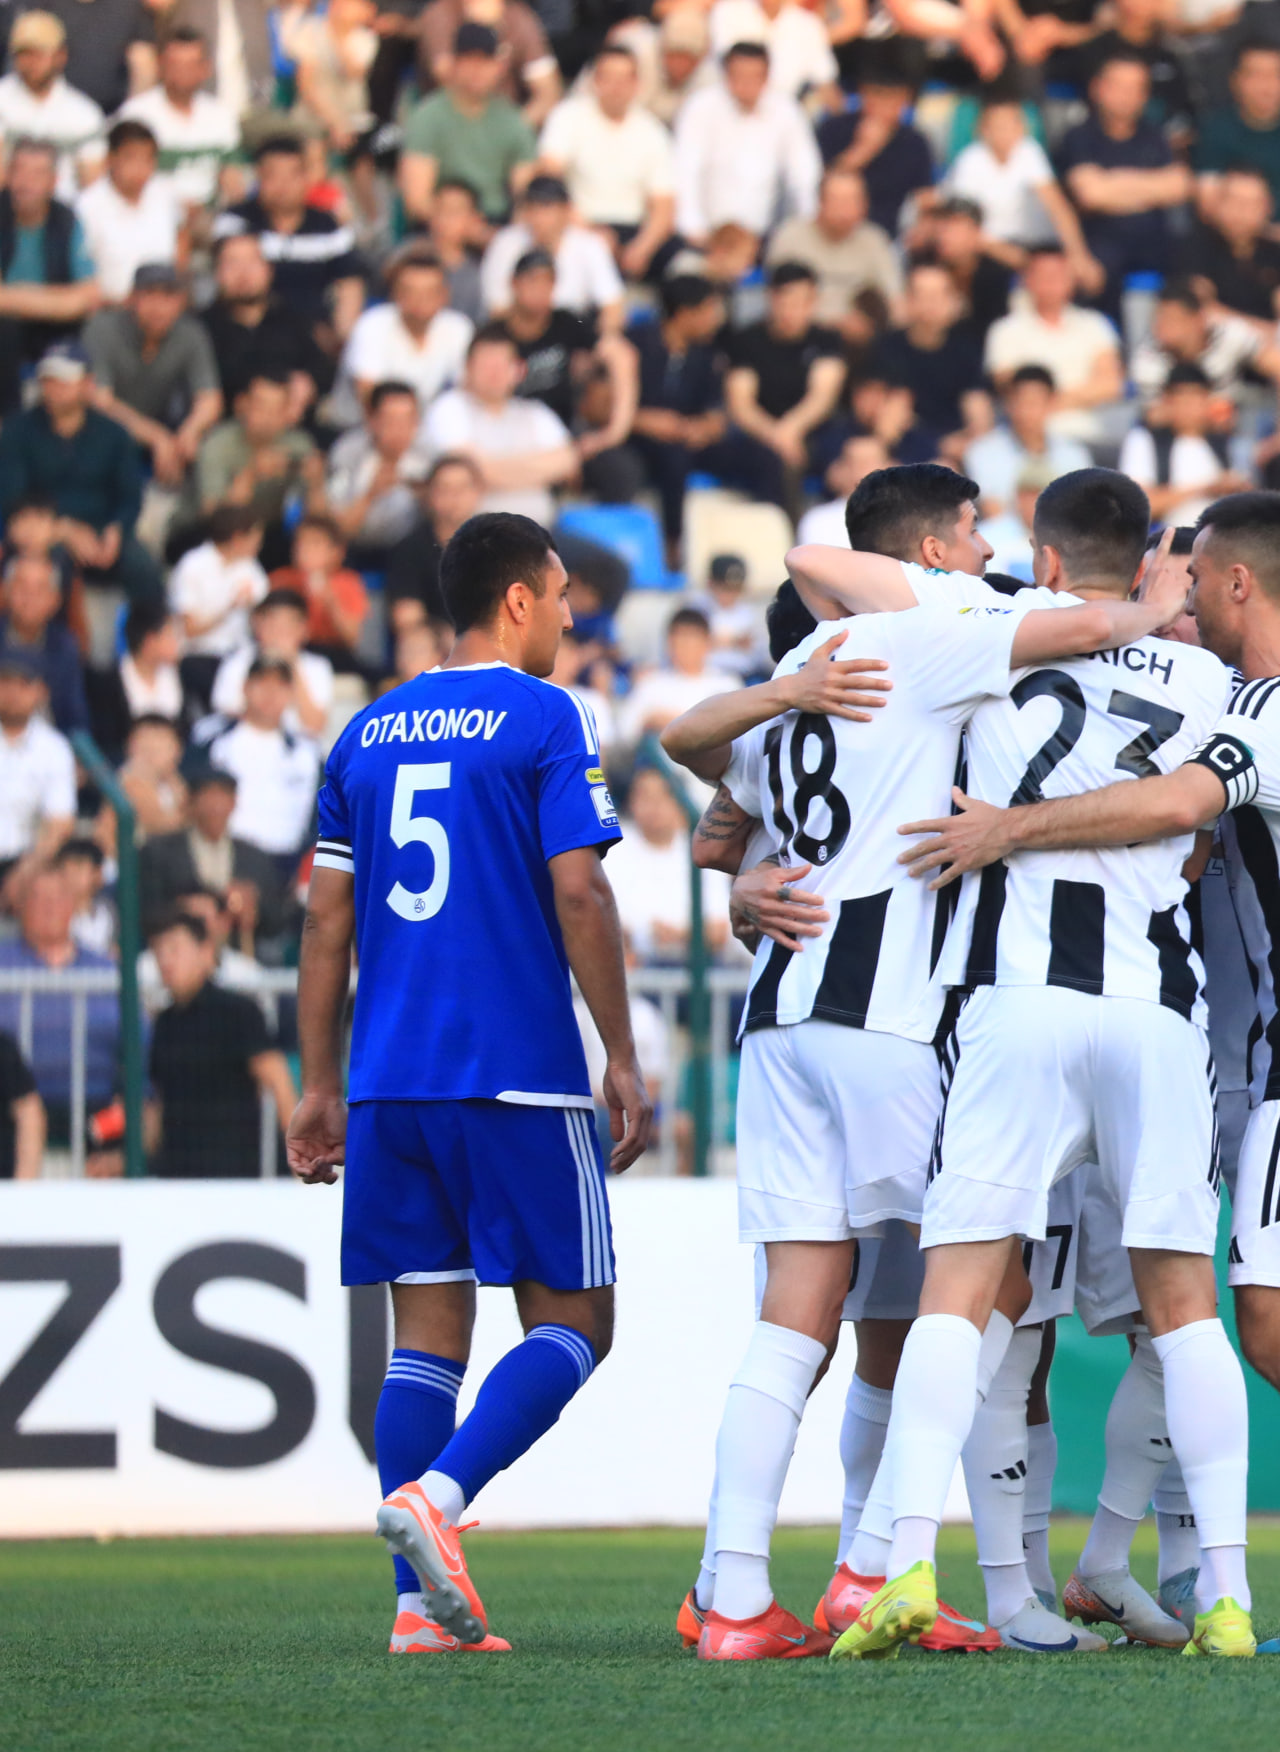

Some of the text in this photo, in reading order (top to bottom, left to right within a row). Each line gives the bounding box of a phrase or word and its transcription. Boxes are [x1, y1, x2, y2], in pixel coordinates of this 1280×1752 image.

[361, 708, 507, 748] OTAXONOV
[1209, 743, 1243, 771] C
[763, 710, 851, 866] 18
[386, 761, 451, 921] 5
